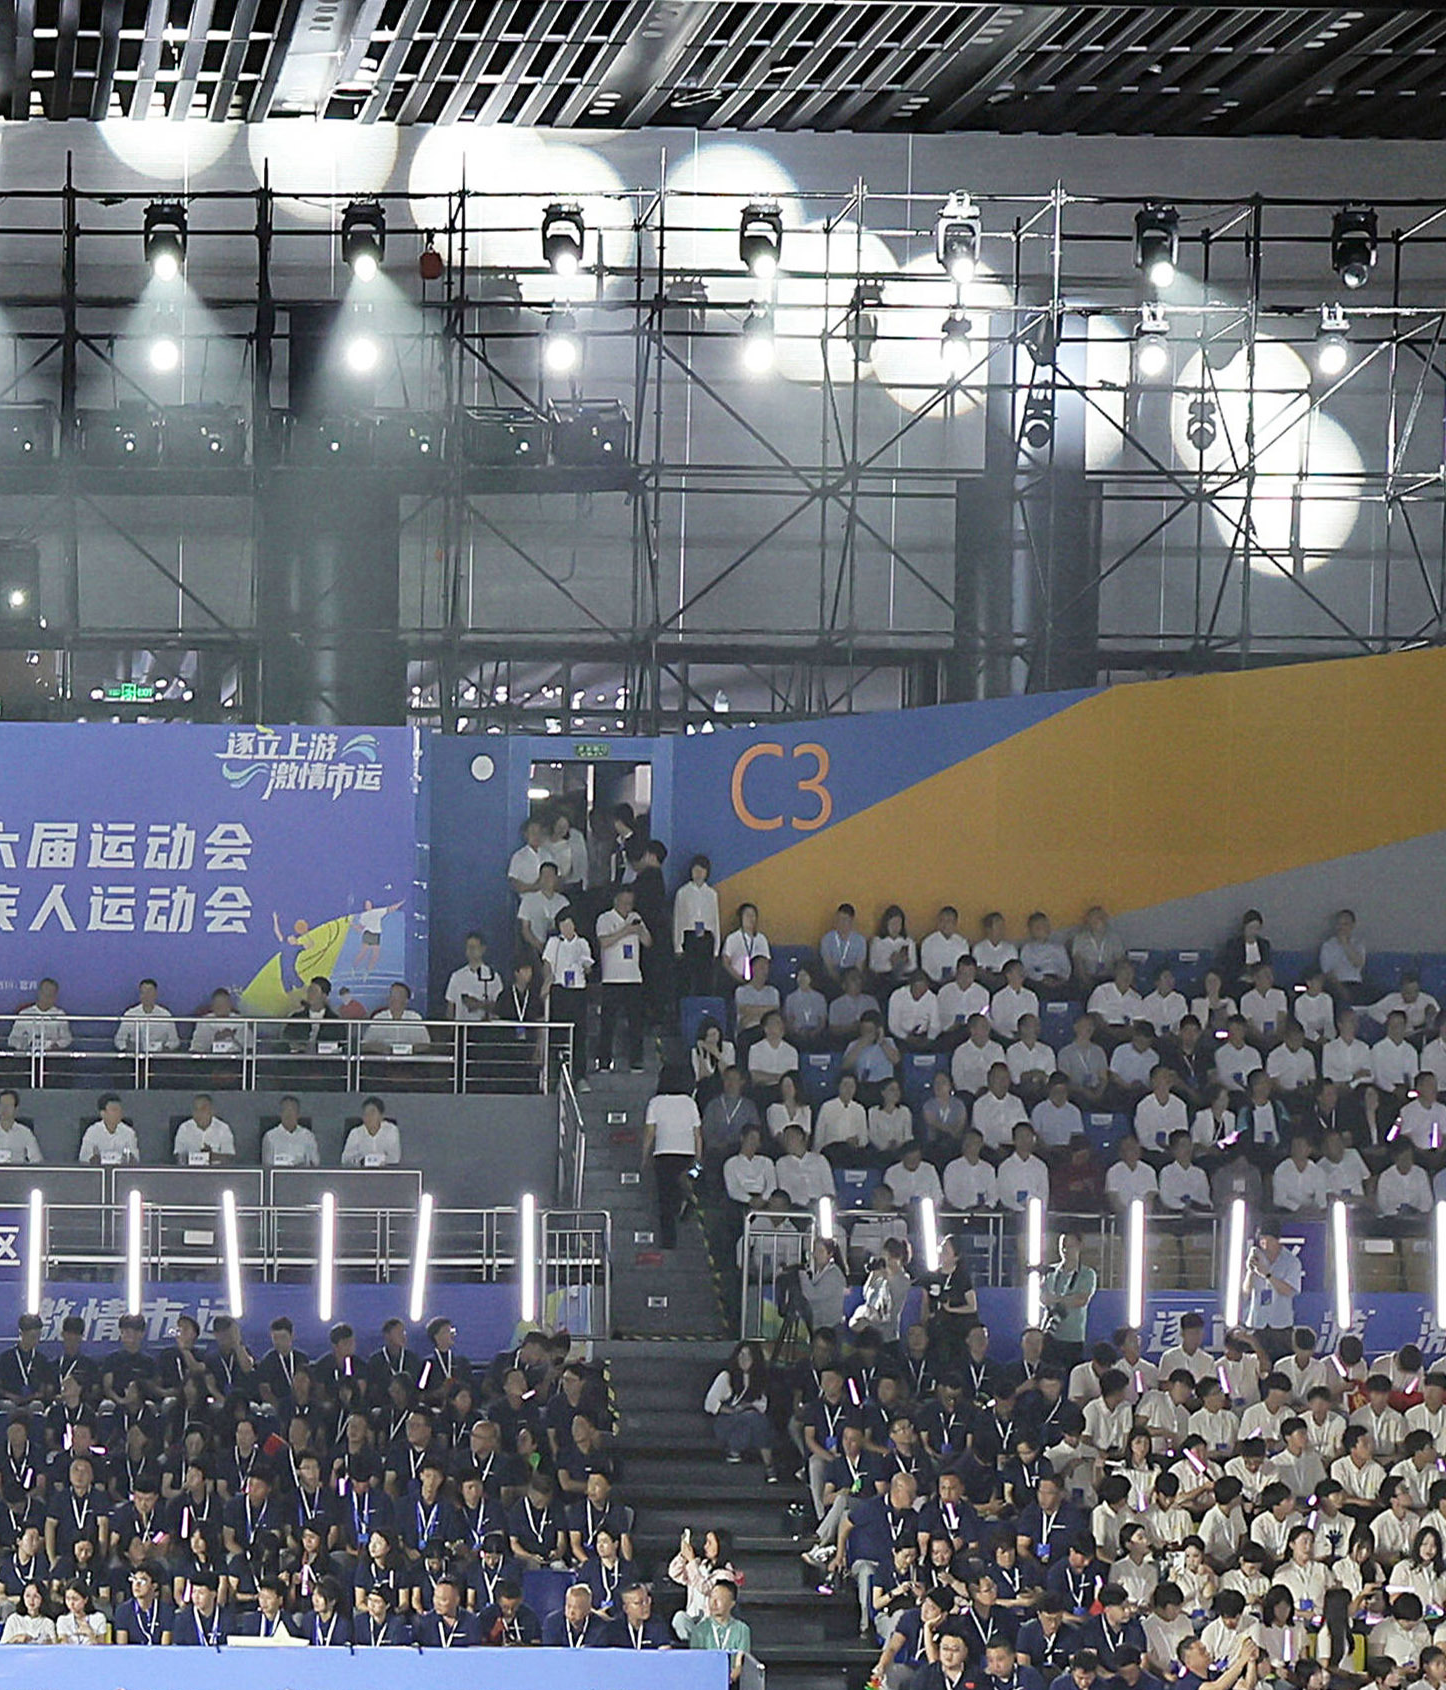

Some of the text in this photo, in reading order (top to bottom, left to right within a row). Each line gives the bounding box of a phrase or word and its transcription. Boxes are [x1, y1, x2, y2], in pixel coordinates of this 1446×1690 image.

[215, 725, 339, 761] 逐立上游
[262, 762, 383, 801] 激情市运
[732, 743, 832, 830] C3
